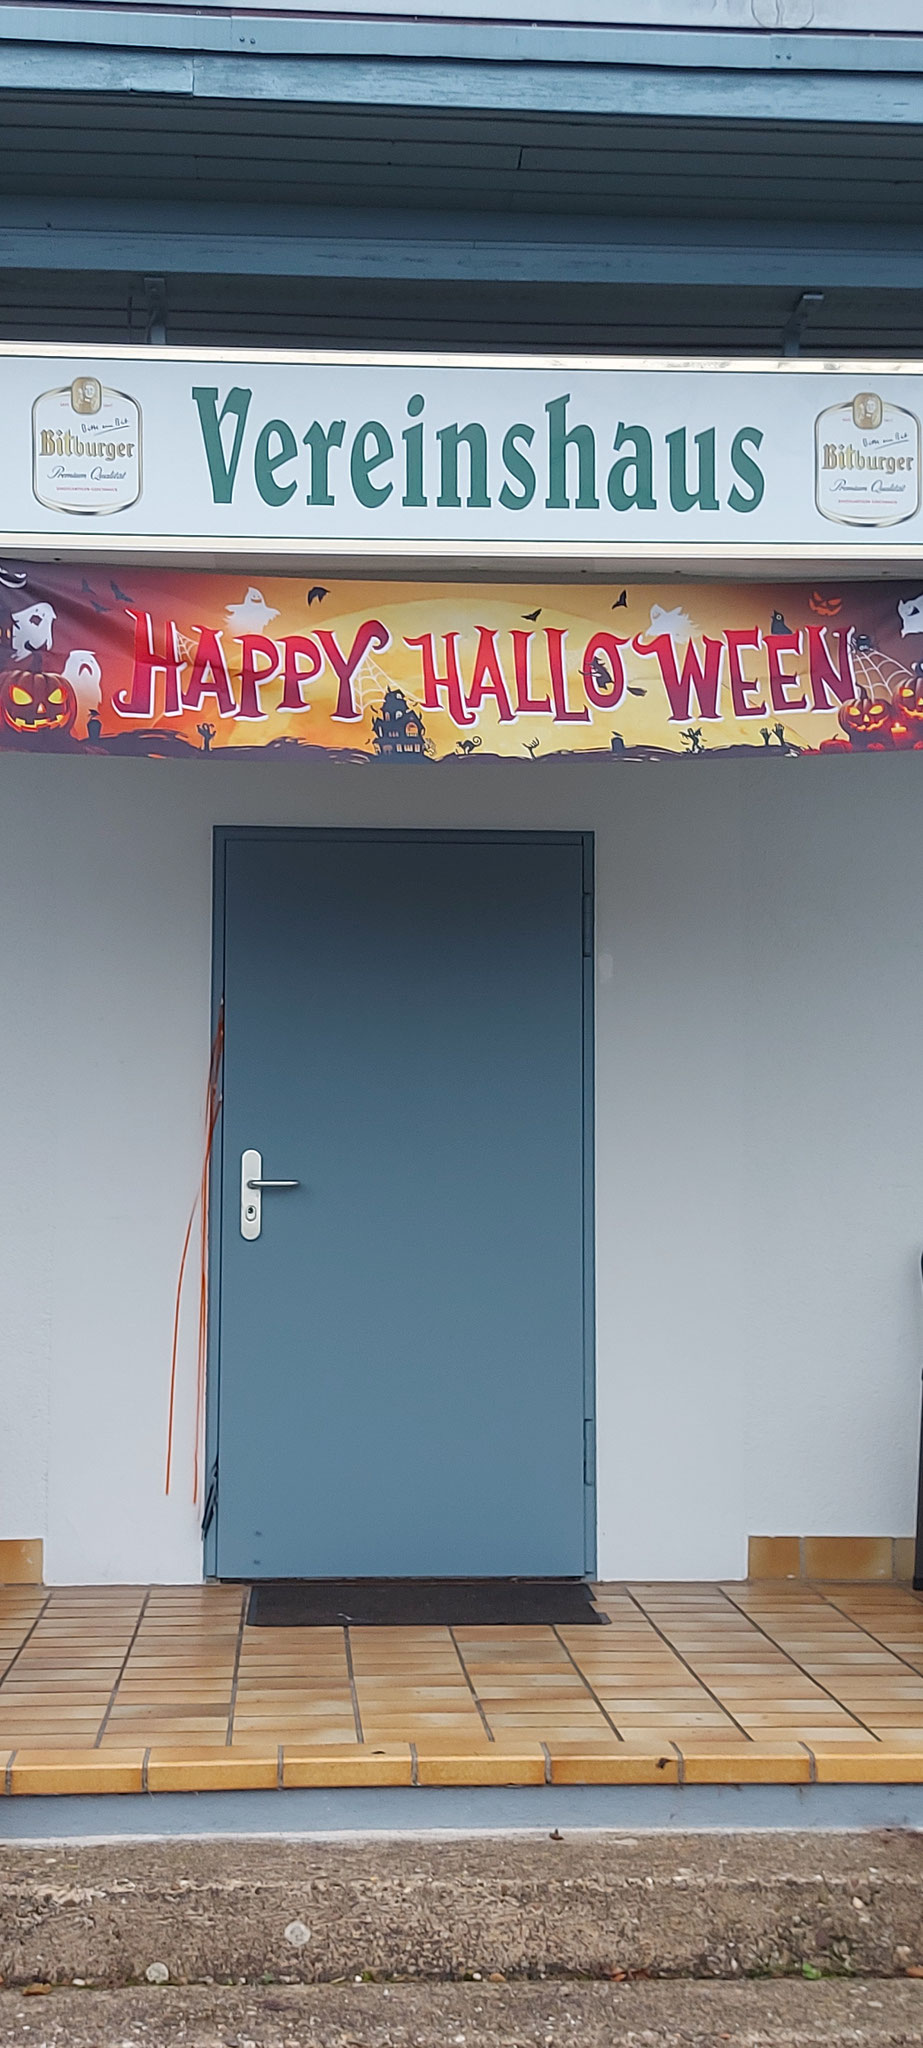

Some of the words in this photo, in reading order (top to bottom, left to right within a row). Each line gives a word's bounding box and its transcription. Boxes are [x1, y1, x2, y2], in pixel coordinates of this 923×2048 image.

[39, 429, 135, 462] Bitburger
[191, 386, 765, 514] Vereinshaus
[821, 442, 914, 474] Bitburger
[111, 608, 392, 722] HAPPY
[402, 624, 859, 727] HALLOWEEN
